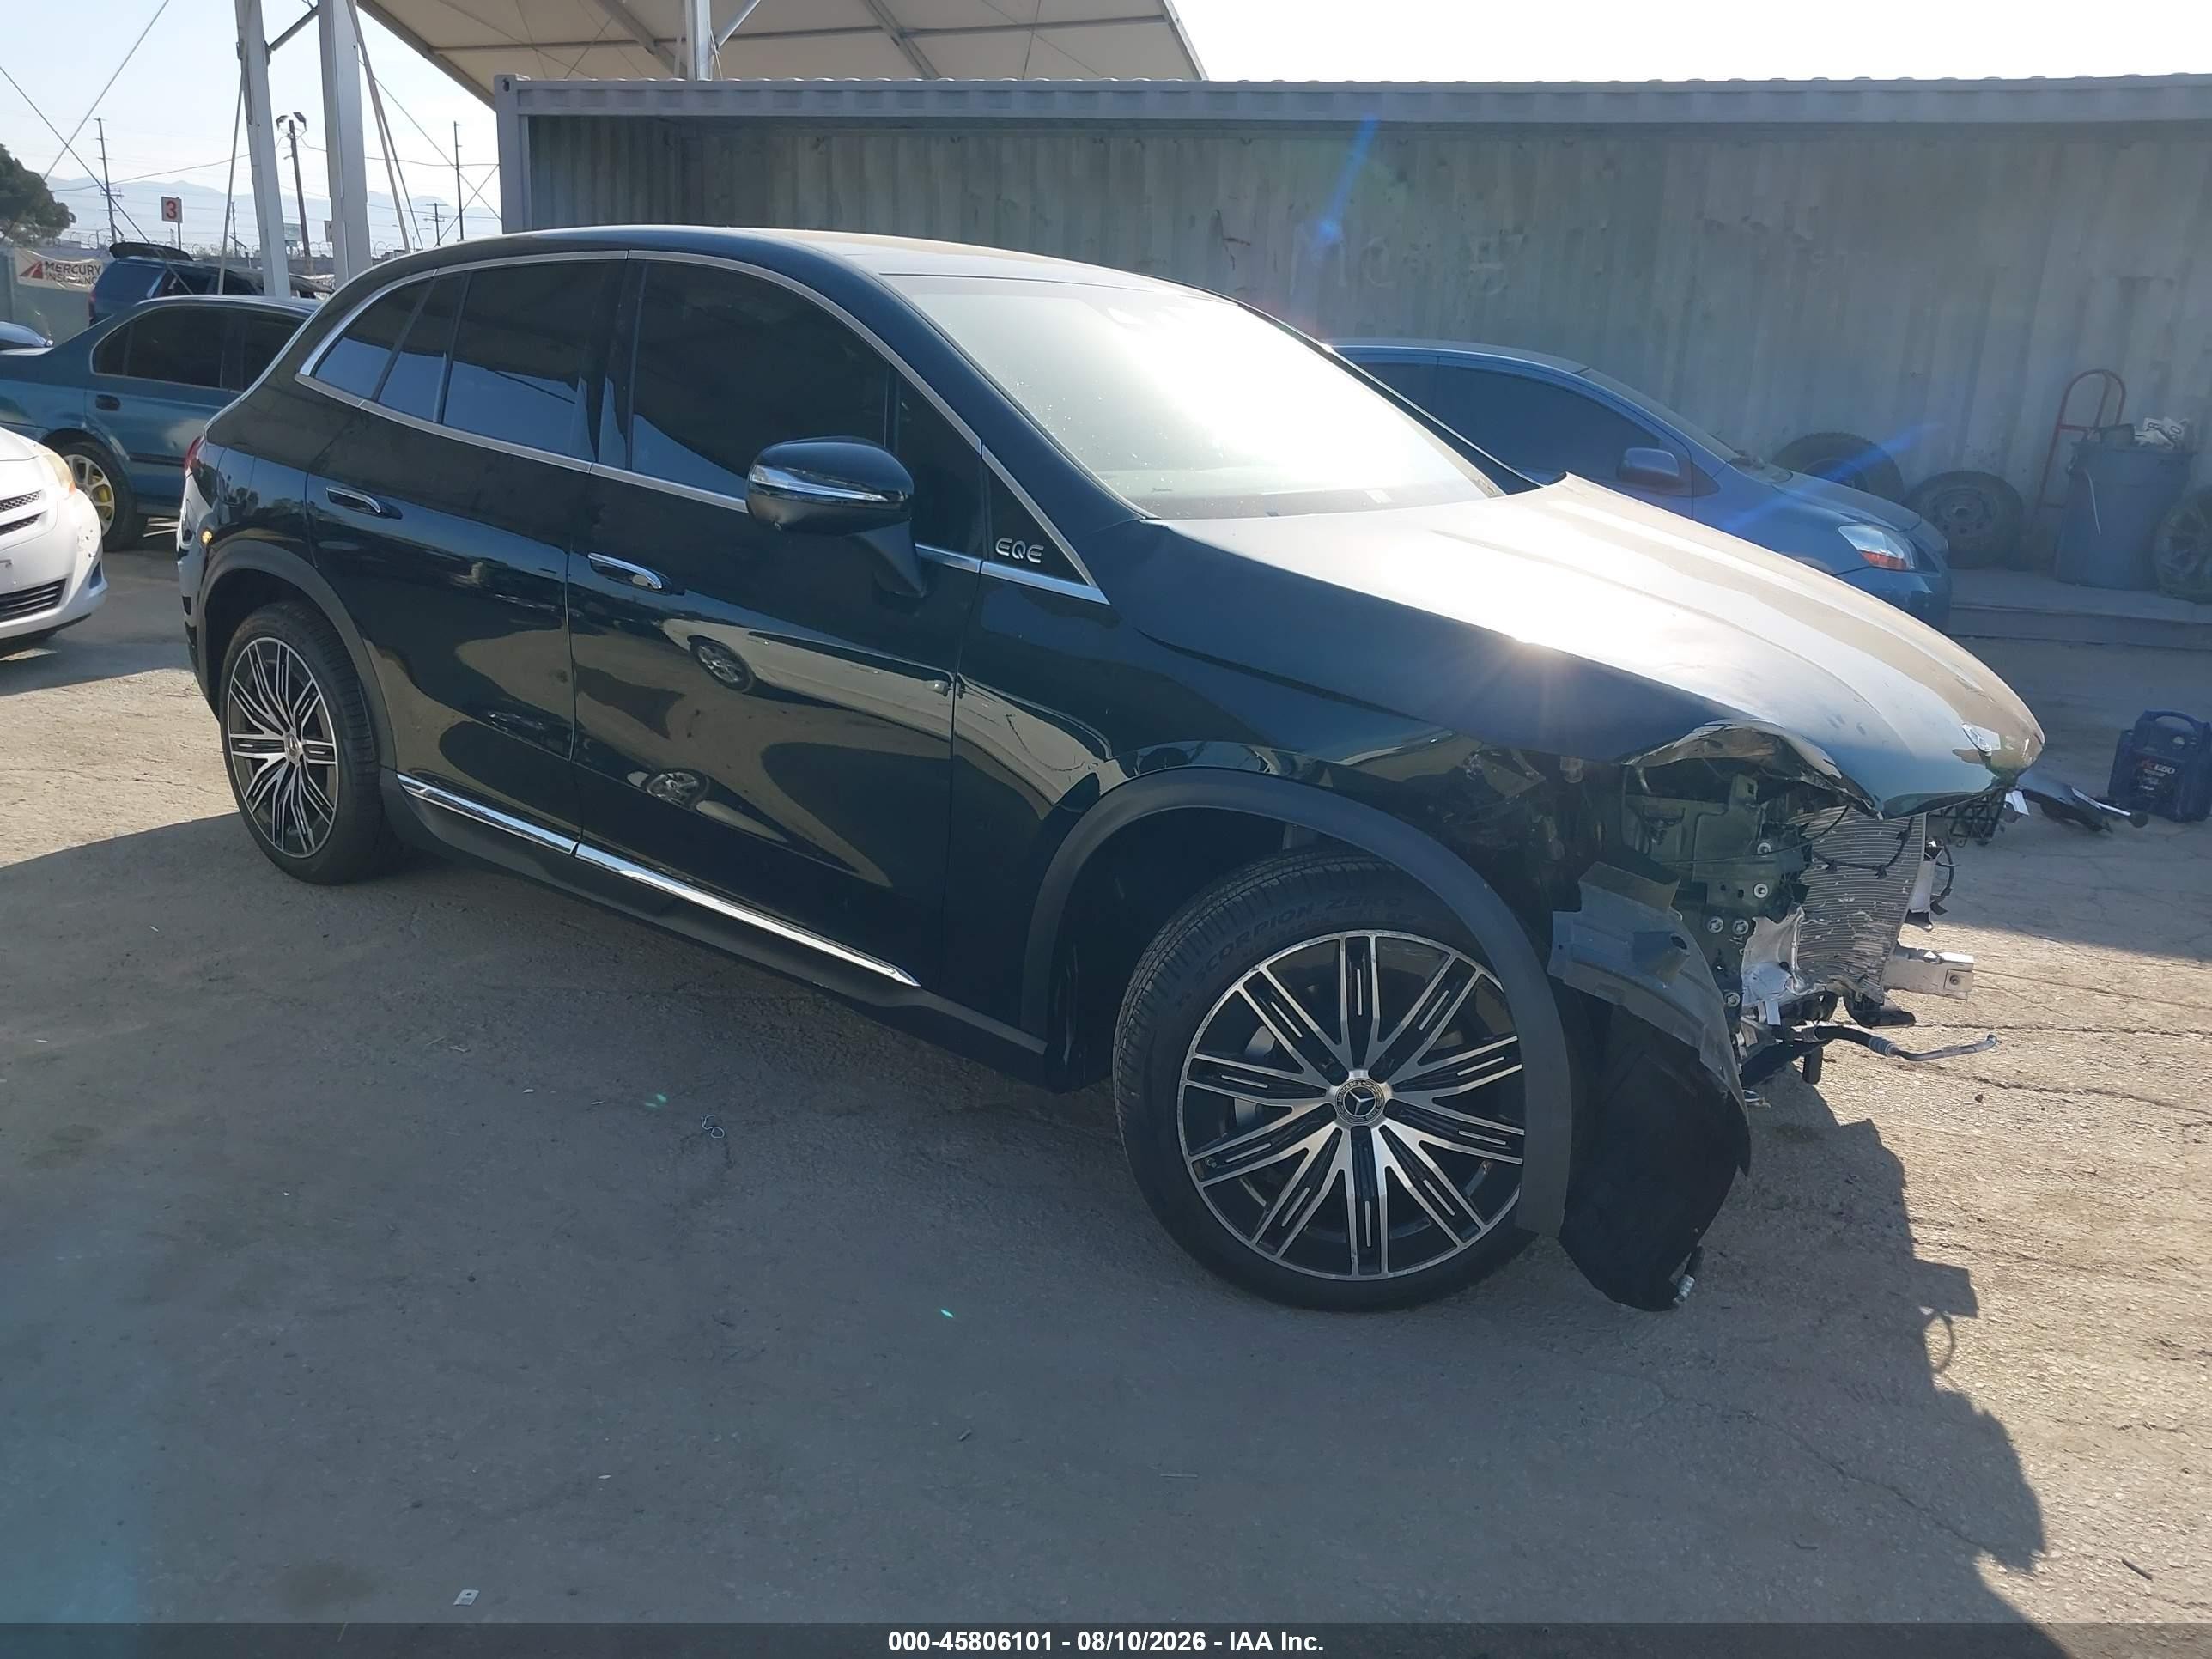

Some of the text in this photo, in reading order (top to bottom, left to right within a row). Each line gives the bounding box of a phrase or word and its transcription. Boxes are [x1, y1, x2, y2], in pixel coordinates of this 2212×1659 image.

[166, 200, 177, 219] 3
[45, 261, 101, 275] MERCURY
[996, 537, 1044, 563] EQE
